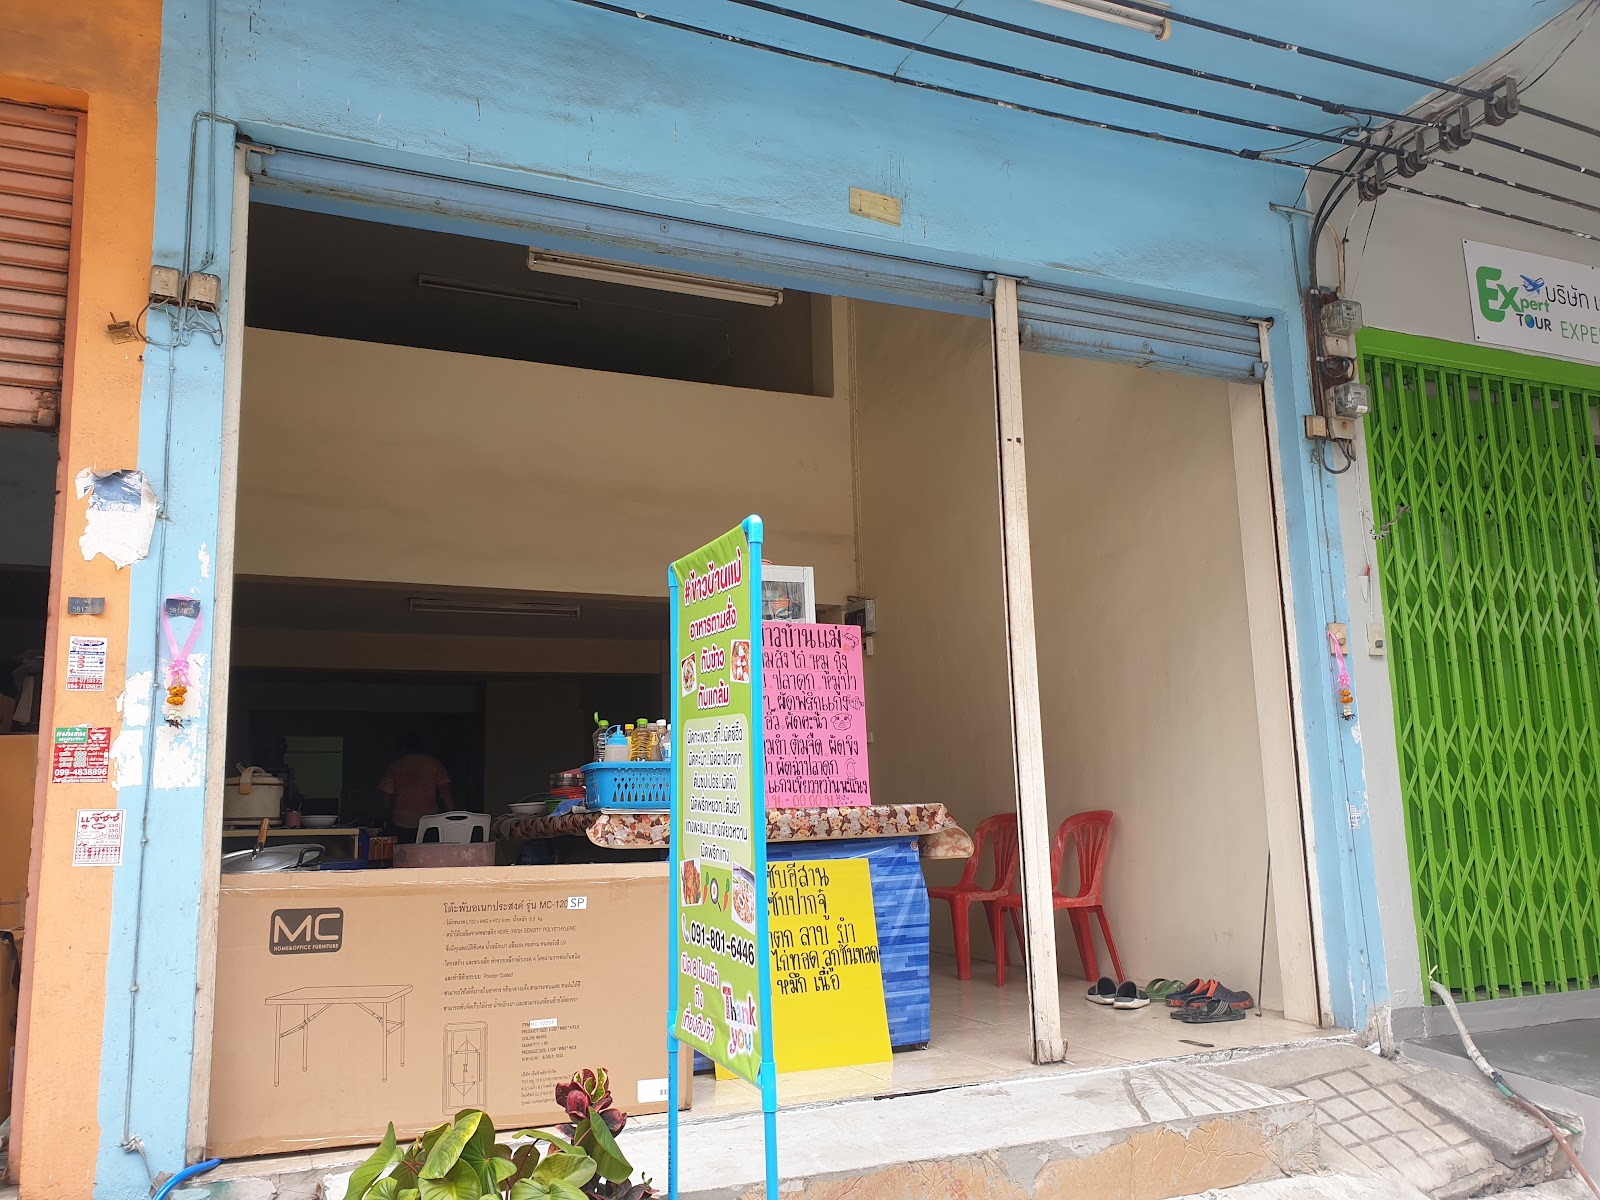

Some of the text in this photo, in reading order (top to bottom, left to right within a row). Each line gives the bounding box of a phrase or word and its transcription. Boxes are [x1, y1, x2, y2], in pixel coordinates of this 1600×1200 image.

[1476, 266, 1549, 322] Expert
[1516, 313, 1552, 331] TOUR
[1560, 320, 1600, 344] EXPE
[684, 548, 742, 606] #ข้าวบ้านแม่
[690, 597, 737, 641] อาหารตามสั่ง
[700, 644, 725, 674] กับข้าว
[697, 678, 730, 709] กับแกล้ม
[767, 862, 830, 888] ซ่บอีสาน
[767, 887, 830, 921] ซ่บปากจู๋
[273, 912, 341, 943] MC
[800, 926, 829, 946] ลาบ
[837, 917, 856, 944] ยำ
[690, 921, 756, 967] 091-801-6446
[771, 949, 820, 971] ไก่ทอด
[694, 985, 705, 1010] ถึง
[777, 972, 807, 995] หมึก
[722, 986, 757, 1027] Thank
[729, 1027, 752, 1055] you
